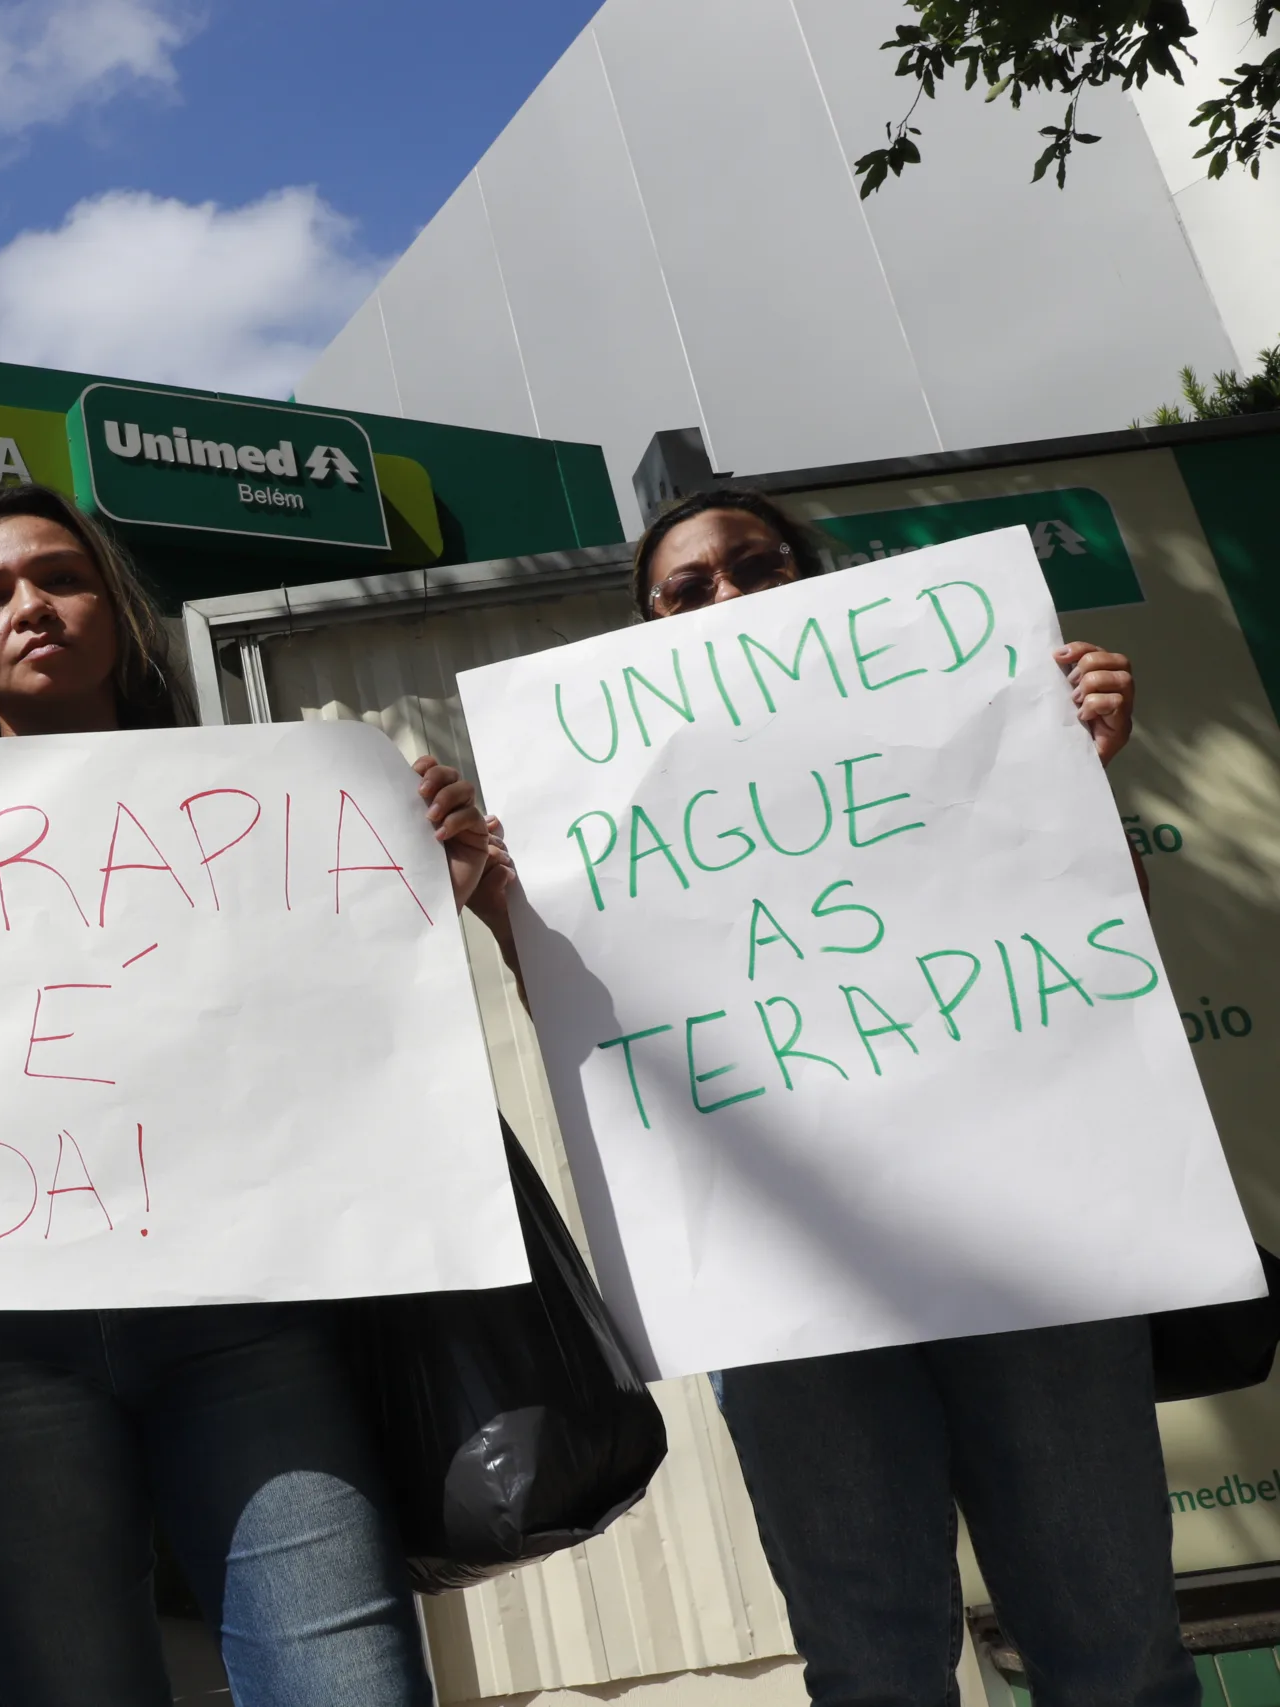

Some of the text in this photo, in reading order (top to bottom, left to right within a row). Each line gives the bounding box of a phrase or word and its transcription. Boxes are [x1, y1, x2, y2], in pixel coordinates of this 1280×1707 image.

[103, 420, 299, 478] Unimed
[237, 483, 304, 510] Belém
[554, 580, 1018, 764] UNIMED,
[566, 752, 926, 912] PAGUE
[748, 879, 885, 981] AS
[24, 943, 159, 1085] É
[597, 918, 1159, 1130] TERAPIAS
[1169, 1468, 1280, 1514] medbel
